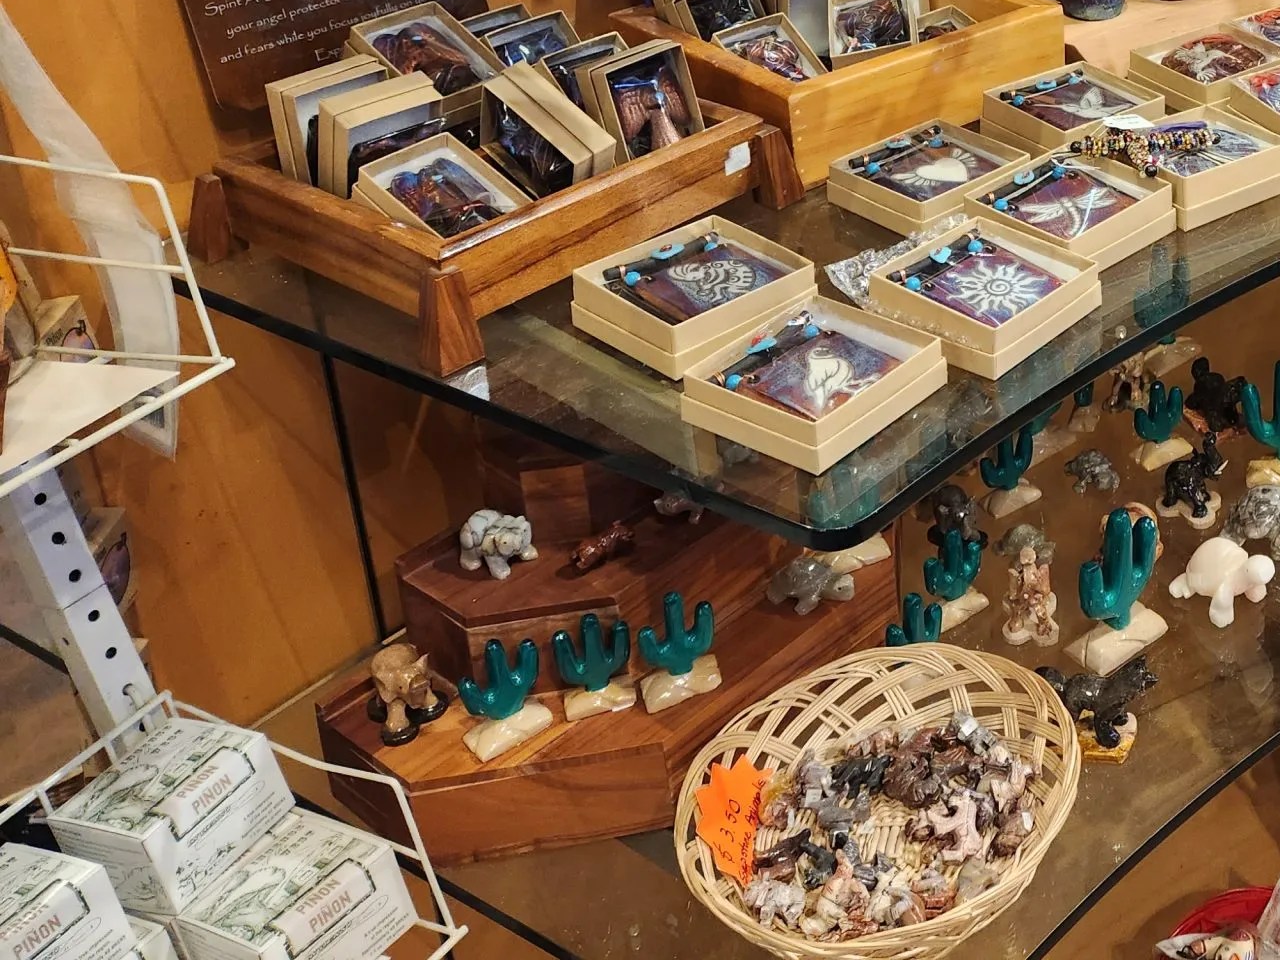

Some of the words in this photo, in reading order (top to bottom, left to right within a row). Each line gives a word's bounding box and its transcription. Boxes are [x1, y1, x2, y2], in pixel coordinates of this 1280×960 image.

[220, 48, 243, 64] and
[244, 41, 275, 56] fears
[276, 31, 305, 46] while
[306, 24, 328, 41] you
[329, 16, 359, 30] focus
